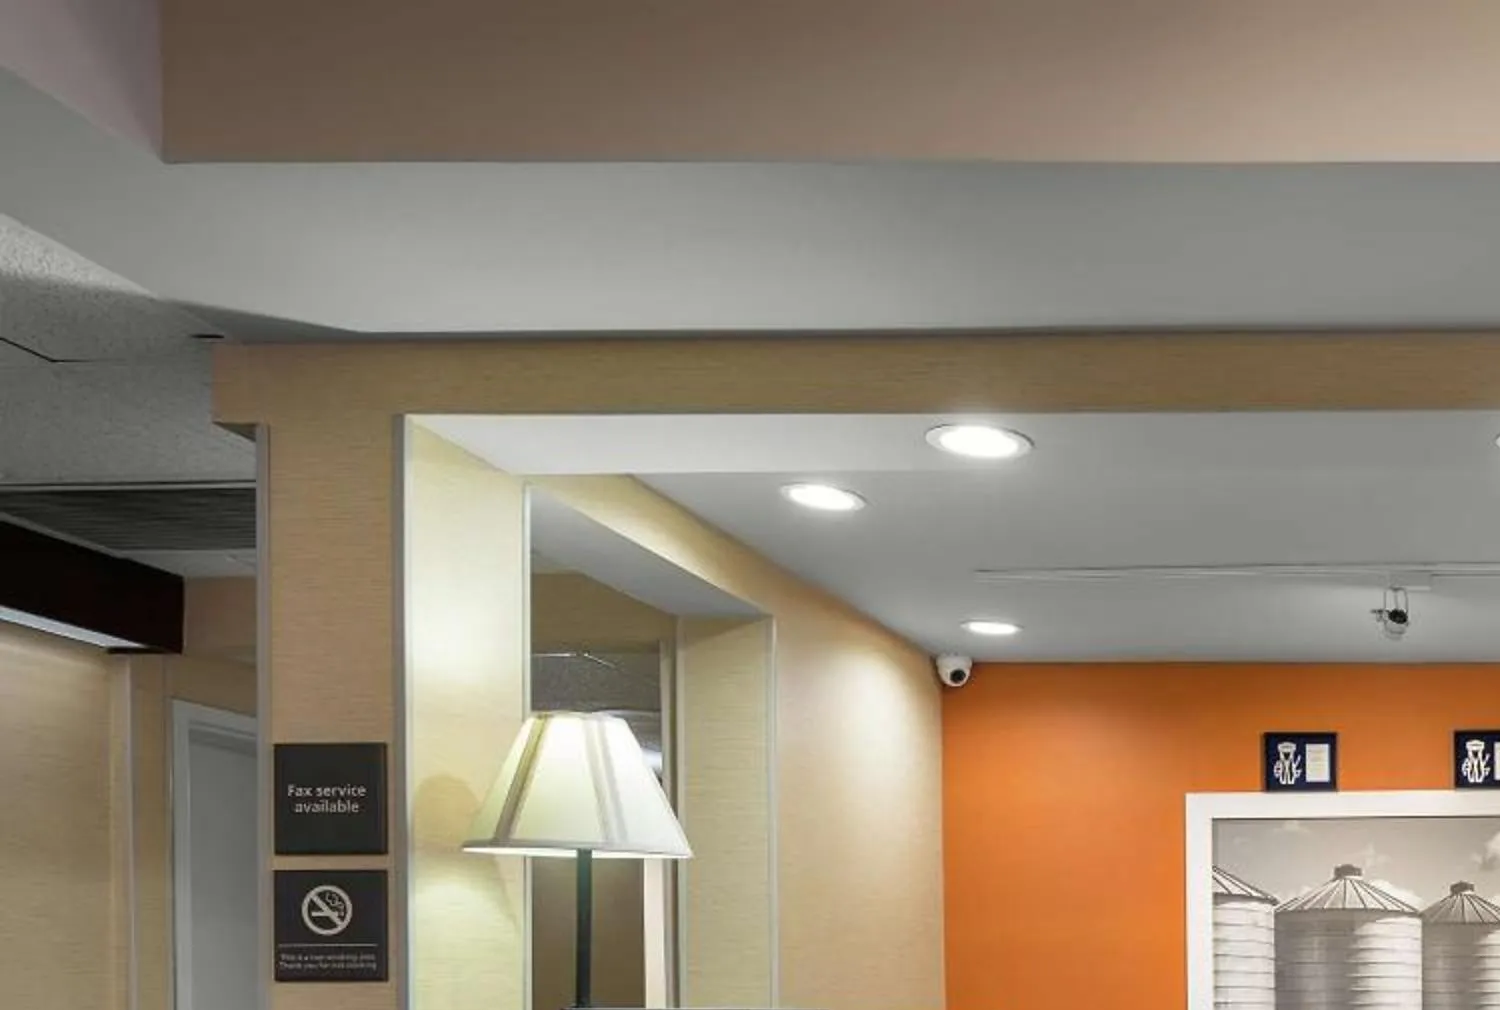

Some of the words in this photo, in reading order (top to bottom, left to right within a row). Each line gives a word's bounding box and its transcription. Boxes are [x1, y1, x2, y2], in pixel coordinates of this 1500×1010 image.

[287, 784, 313, 797] Fax
[315, 784, 367, 797] service
[295, 799, 360, 813] available
